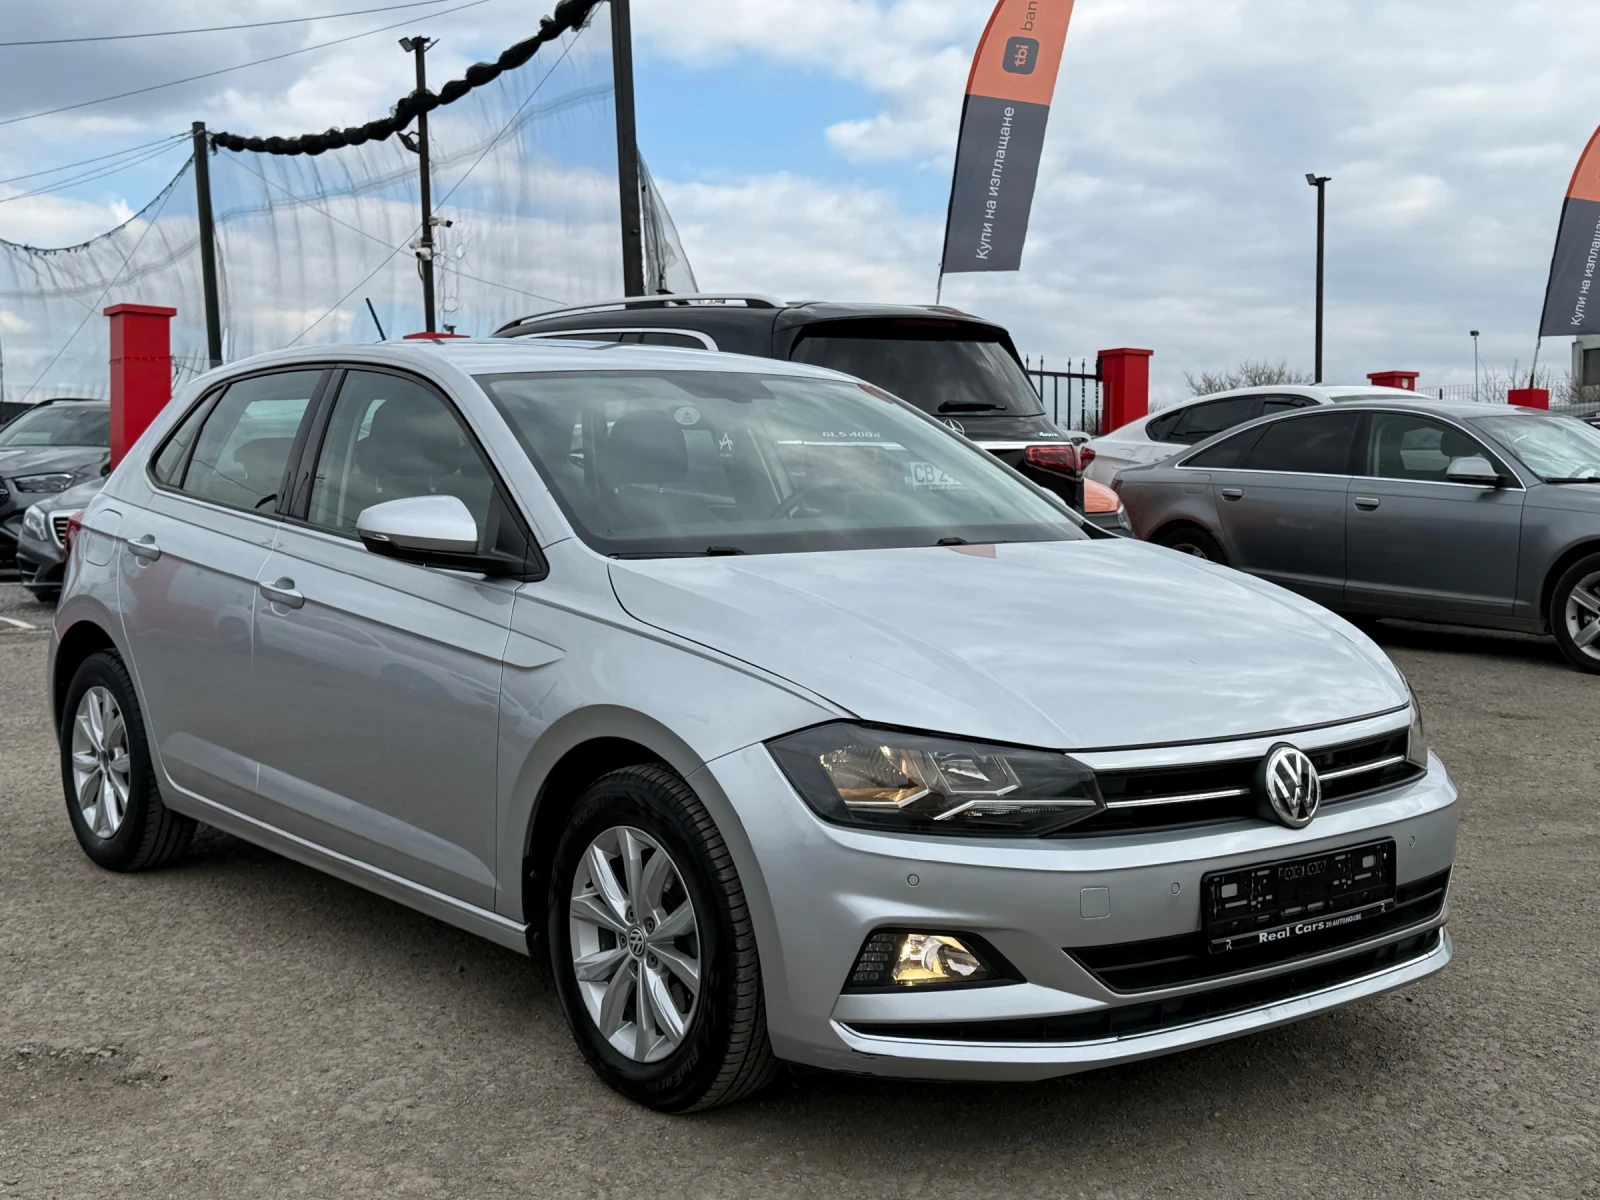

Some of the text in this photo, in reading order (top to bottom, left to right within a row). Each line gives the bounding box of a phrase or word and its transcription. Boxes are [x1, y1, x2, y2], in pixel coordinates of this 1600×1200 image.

[1014, 44, 1029, 66] tbi
[976, 106, 1015, 259] Купи на изплащане
[1570, 296, 1587, 326] Купи
[1580, 280, 1591, 294] на
[913, 464, 936, 484] CB
[1259, 927, 1290, 943] Real
[1295, 921, 1325, 935] Cars
[1332, 913, 1362, 927] AUTOHOUSE
